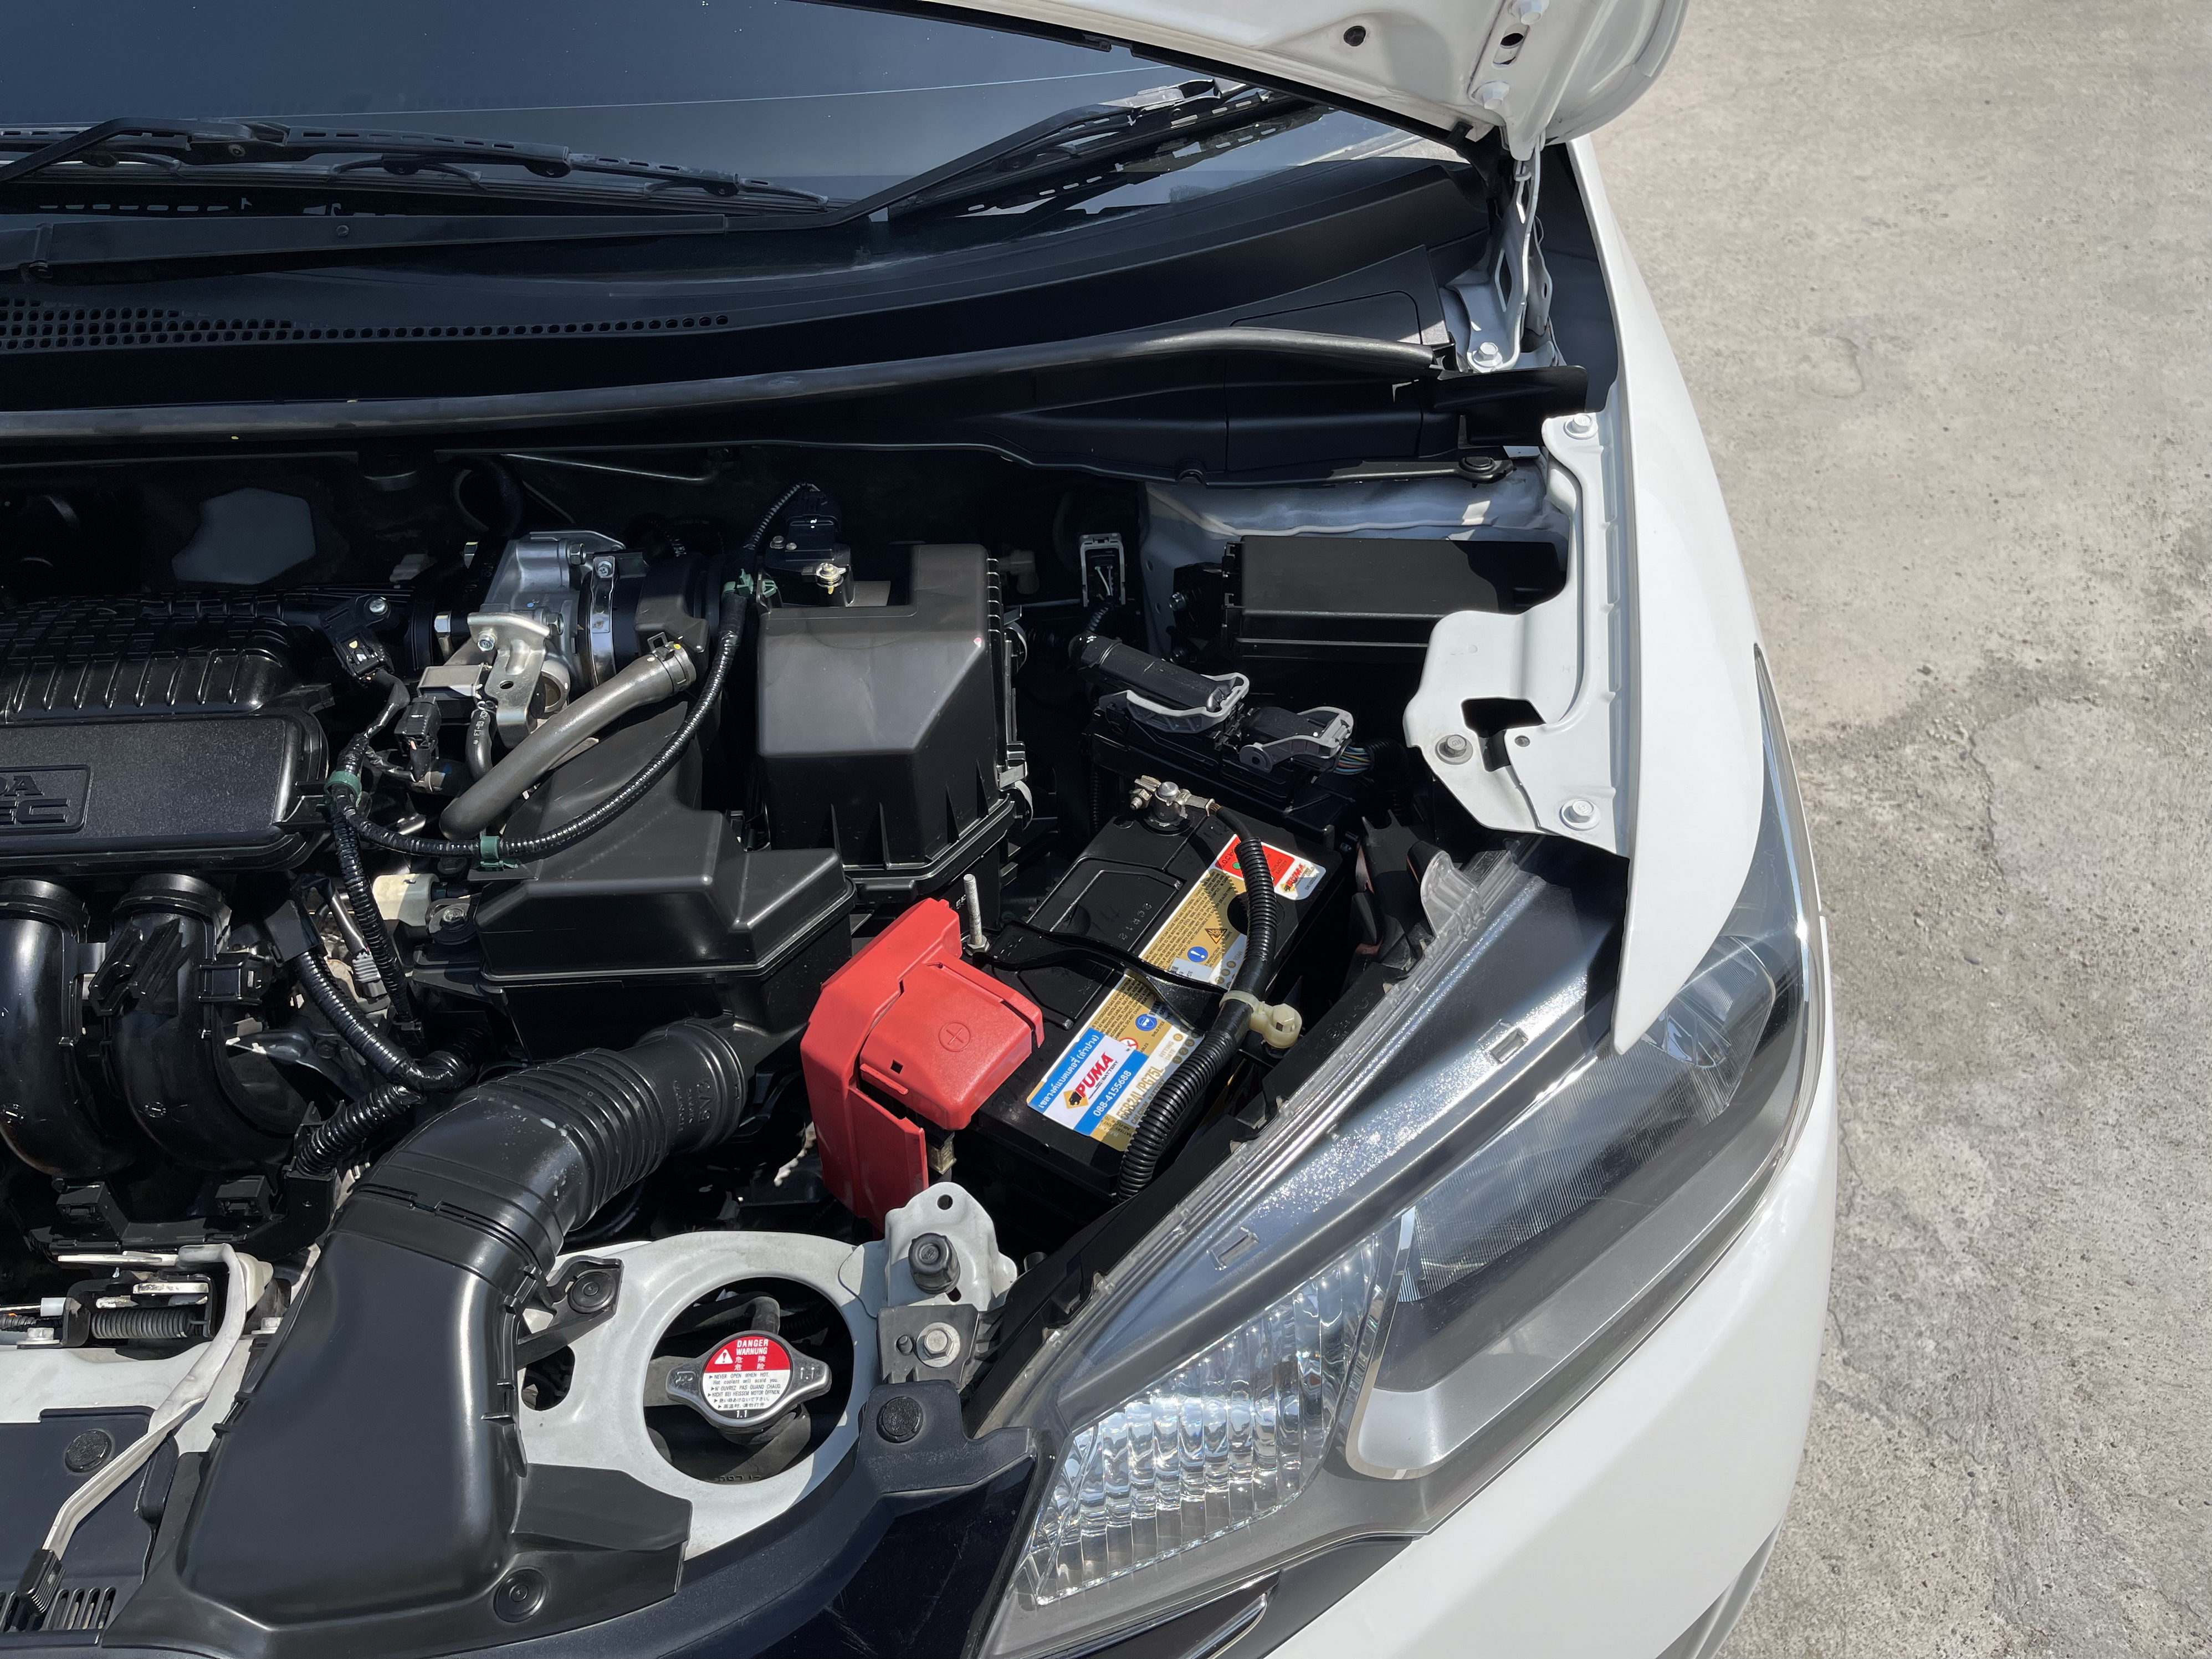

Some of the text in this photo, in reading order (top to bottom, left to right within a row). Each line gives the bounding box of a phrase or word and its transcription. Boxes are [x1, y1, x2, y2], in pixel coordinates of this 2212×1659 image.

[1275, 860, 1288, 874] BATTERY
[1159, 1040, 1174, 1058] FITTING
[1165, 1048, 1176, 1060] DATE
[1075, 1051, 1113, 1098] PUMA
[1101, 1060, 1118, 1081] BATTERY
[1092, 1069, 1132, 1117] 088-4155688
[1115, 1063, 1164, 1121] 55B24L/PG75L
[1130, 1101, 1150, 1124] CALCIUM
[736, 1339, 769, 1348] DANGER
[736, 1347, 767, 1355] WARNUNG
[736, 1410, 747, 1419] 1.1
